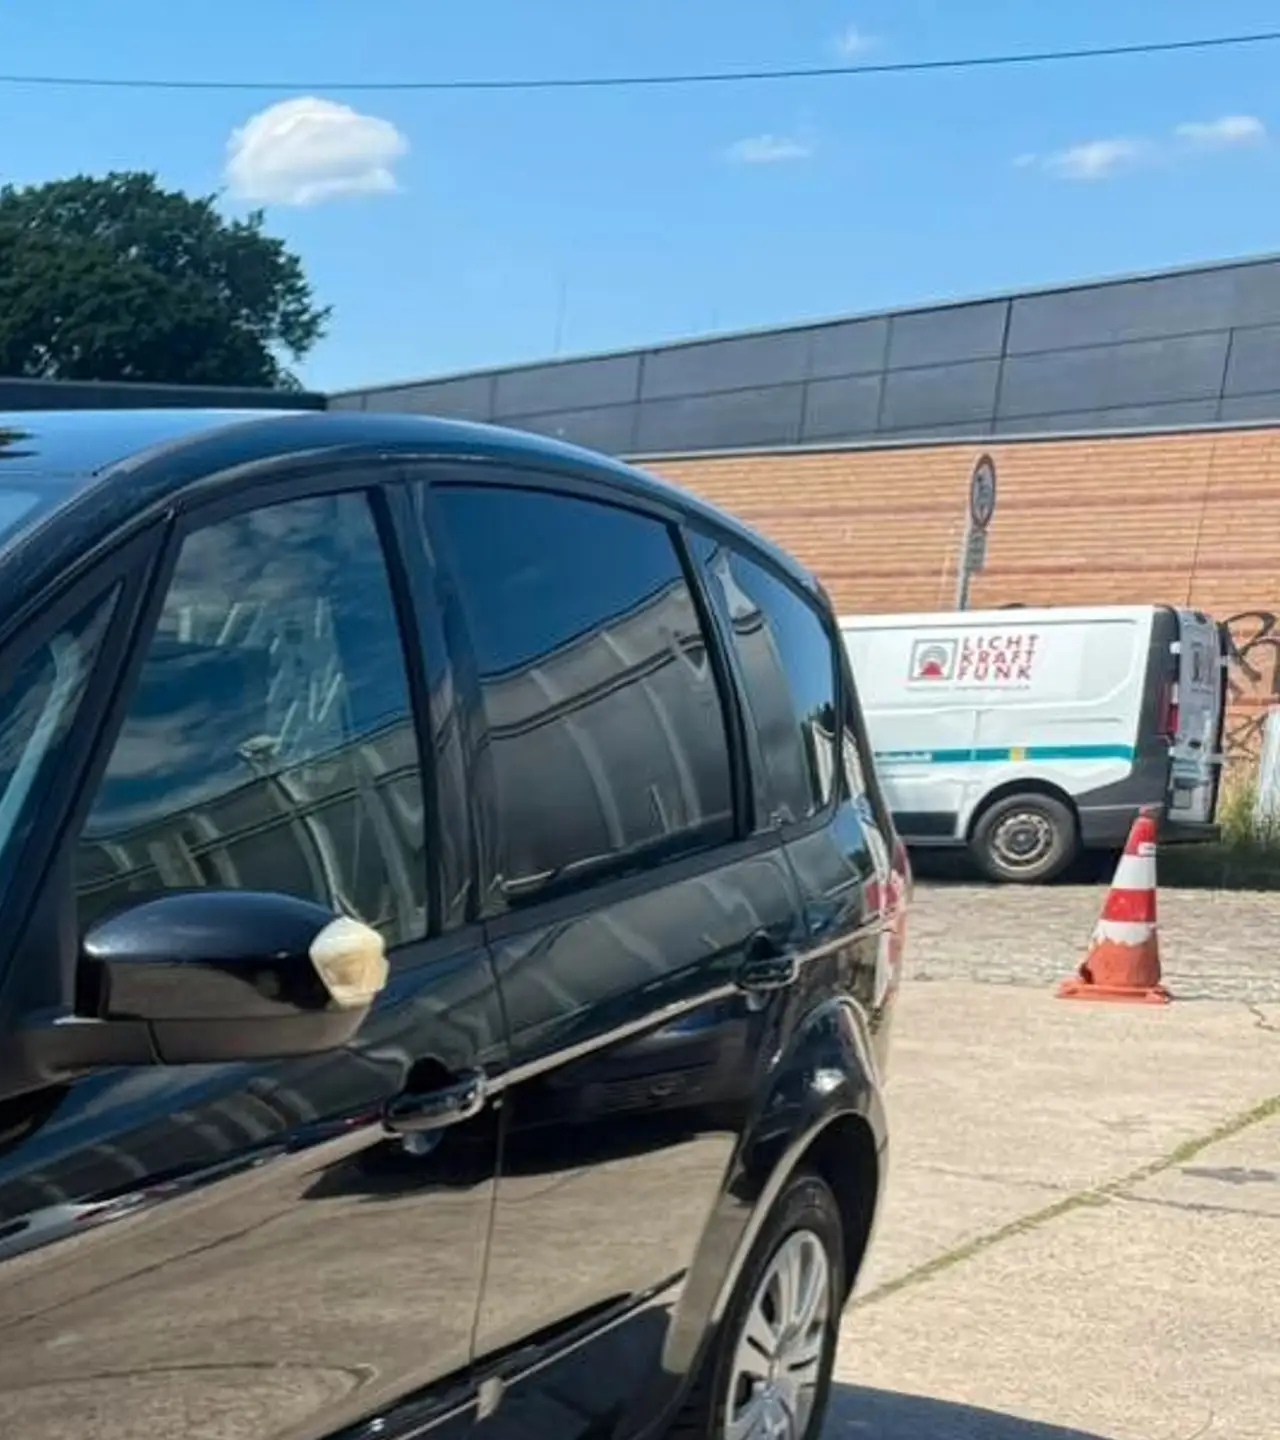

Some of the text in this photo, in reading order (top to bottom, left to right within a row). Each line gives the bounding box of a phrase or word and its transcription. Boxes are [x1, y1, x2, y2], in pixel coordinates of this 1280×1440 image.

[963, 635, 1039, 651] LICHT
[960, 651, 1035, 664] KRAFT
[957, 665, 1031, 680] FUNK
